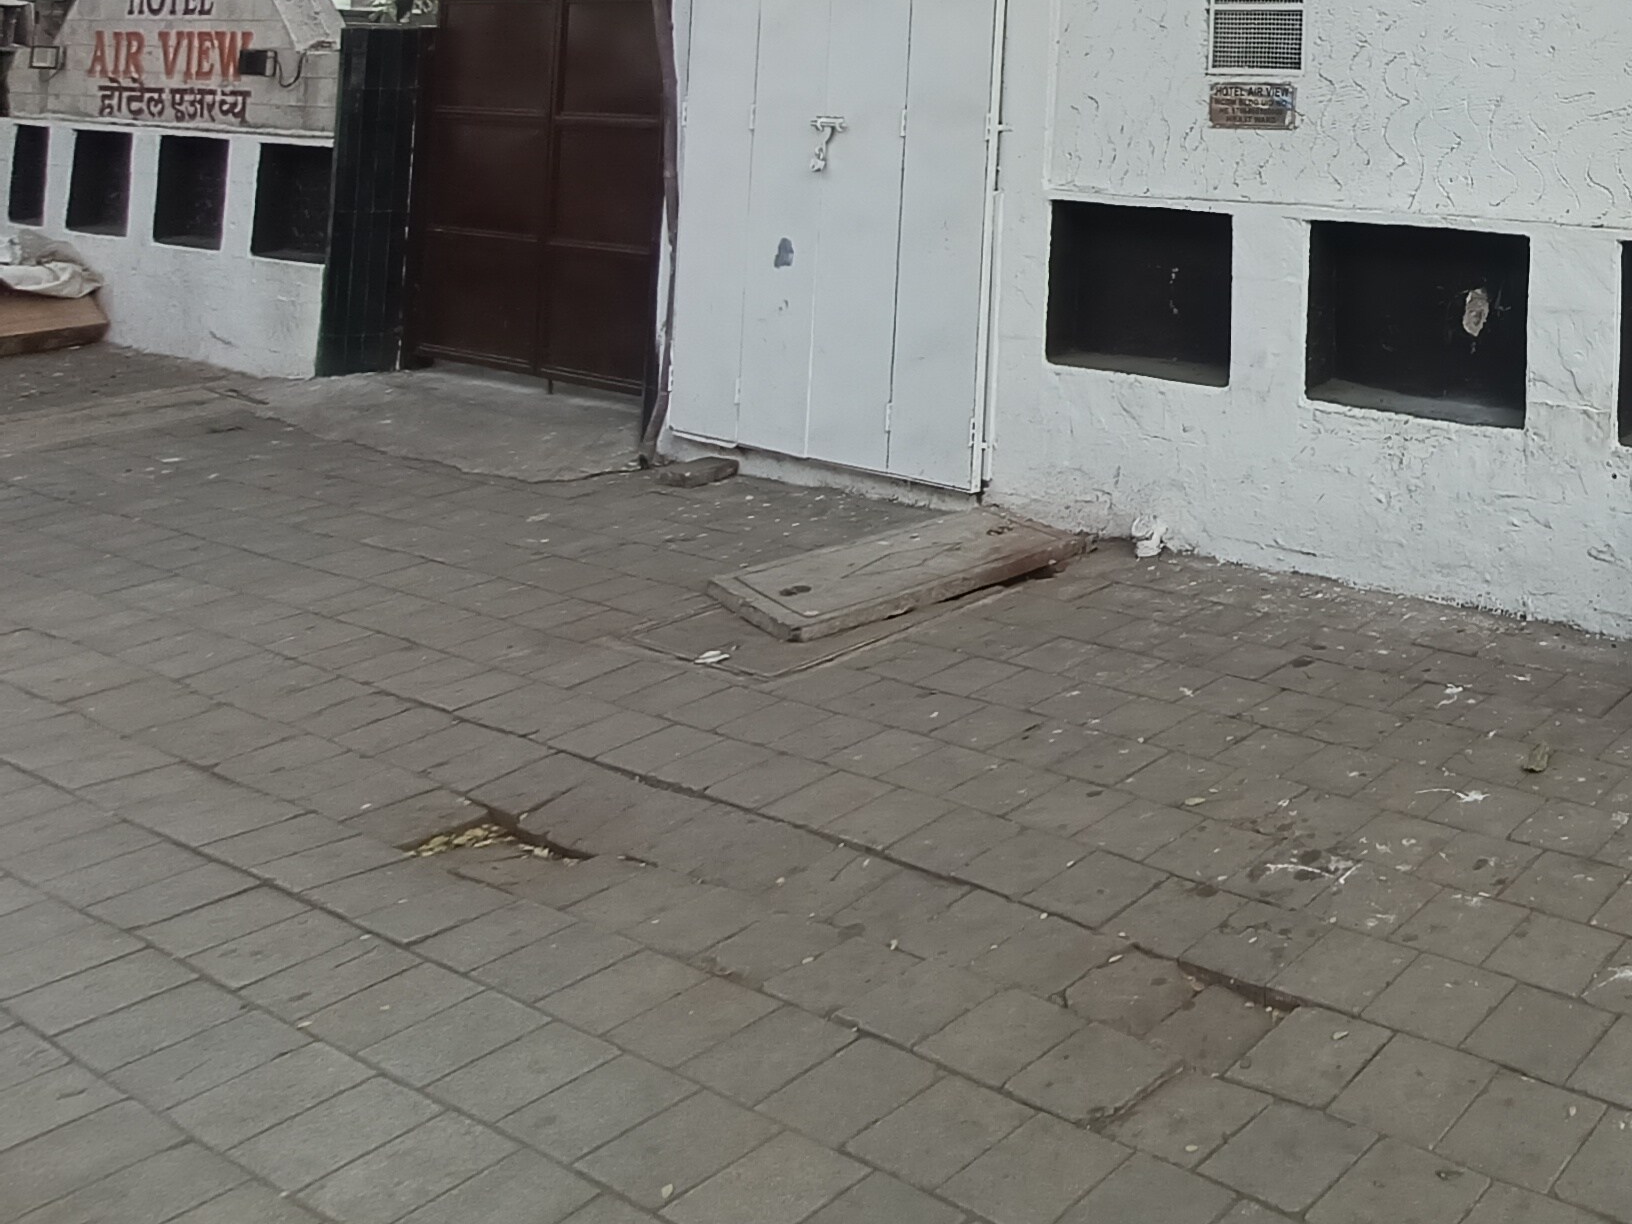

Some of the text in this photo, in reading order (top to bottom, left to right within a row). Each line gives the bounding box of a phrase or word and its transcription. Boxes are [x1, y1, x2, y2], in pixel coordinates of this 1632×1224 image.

[87, 30, 254, 84] AIR VIEW
[1215, 86, 1290, 97] HOTEL AIR VIEW
